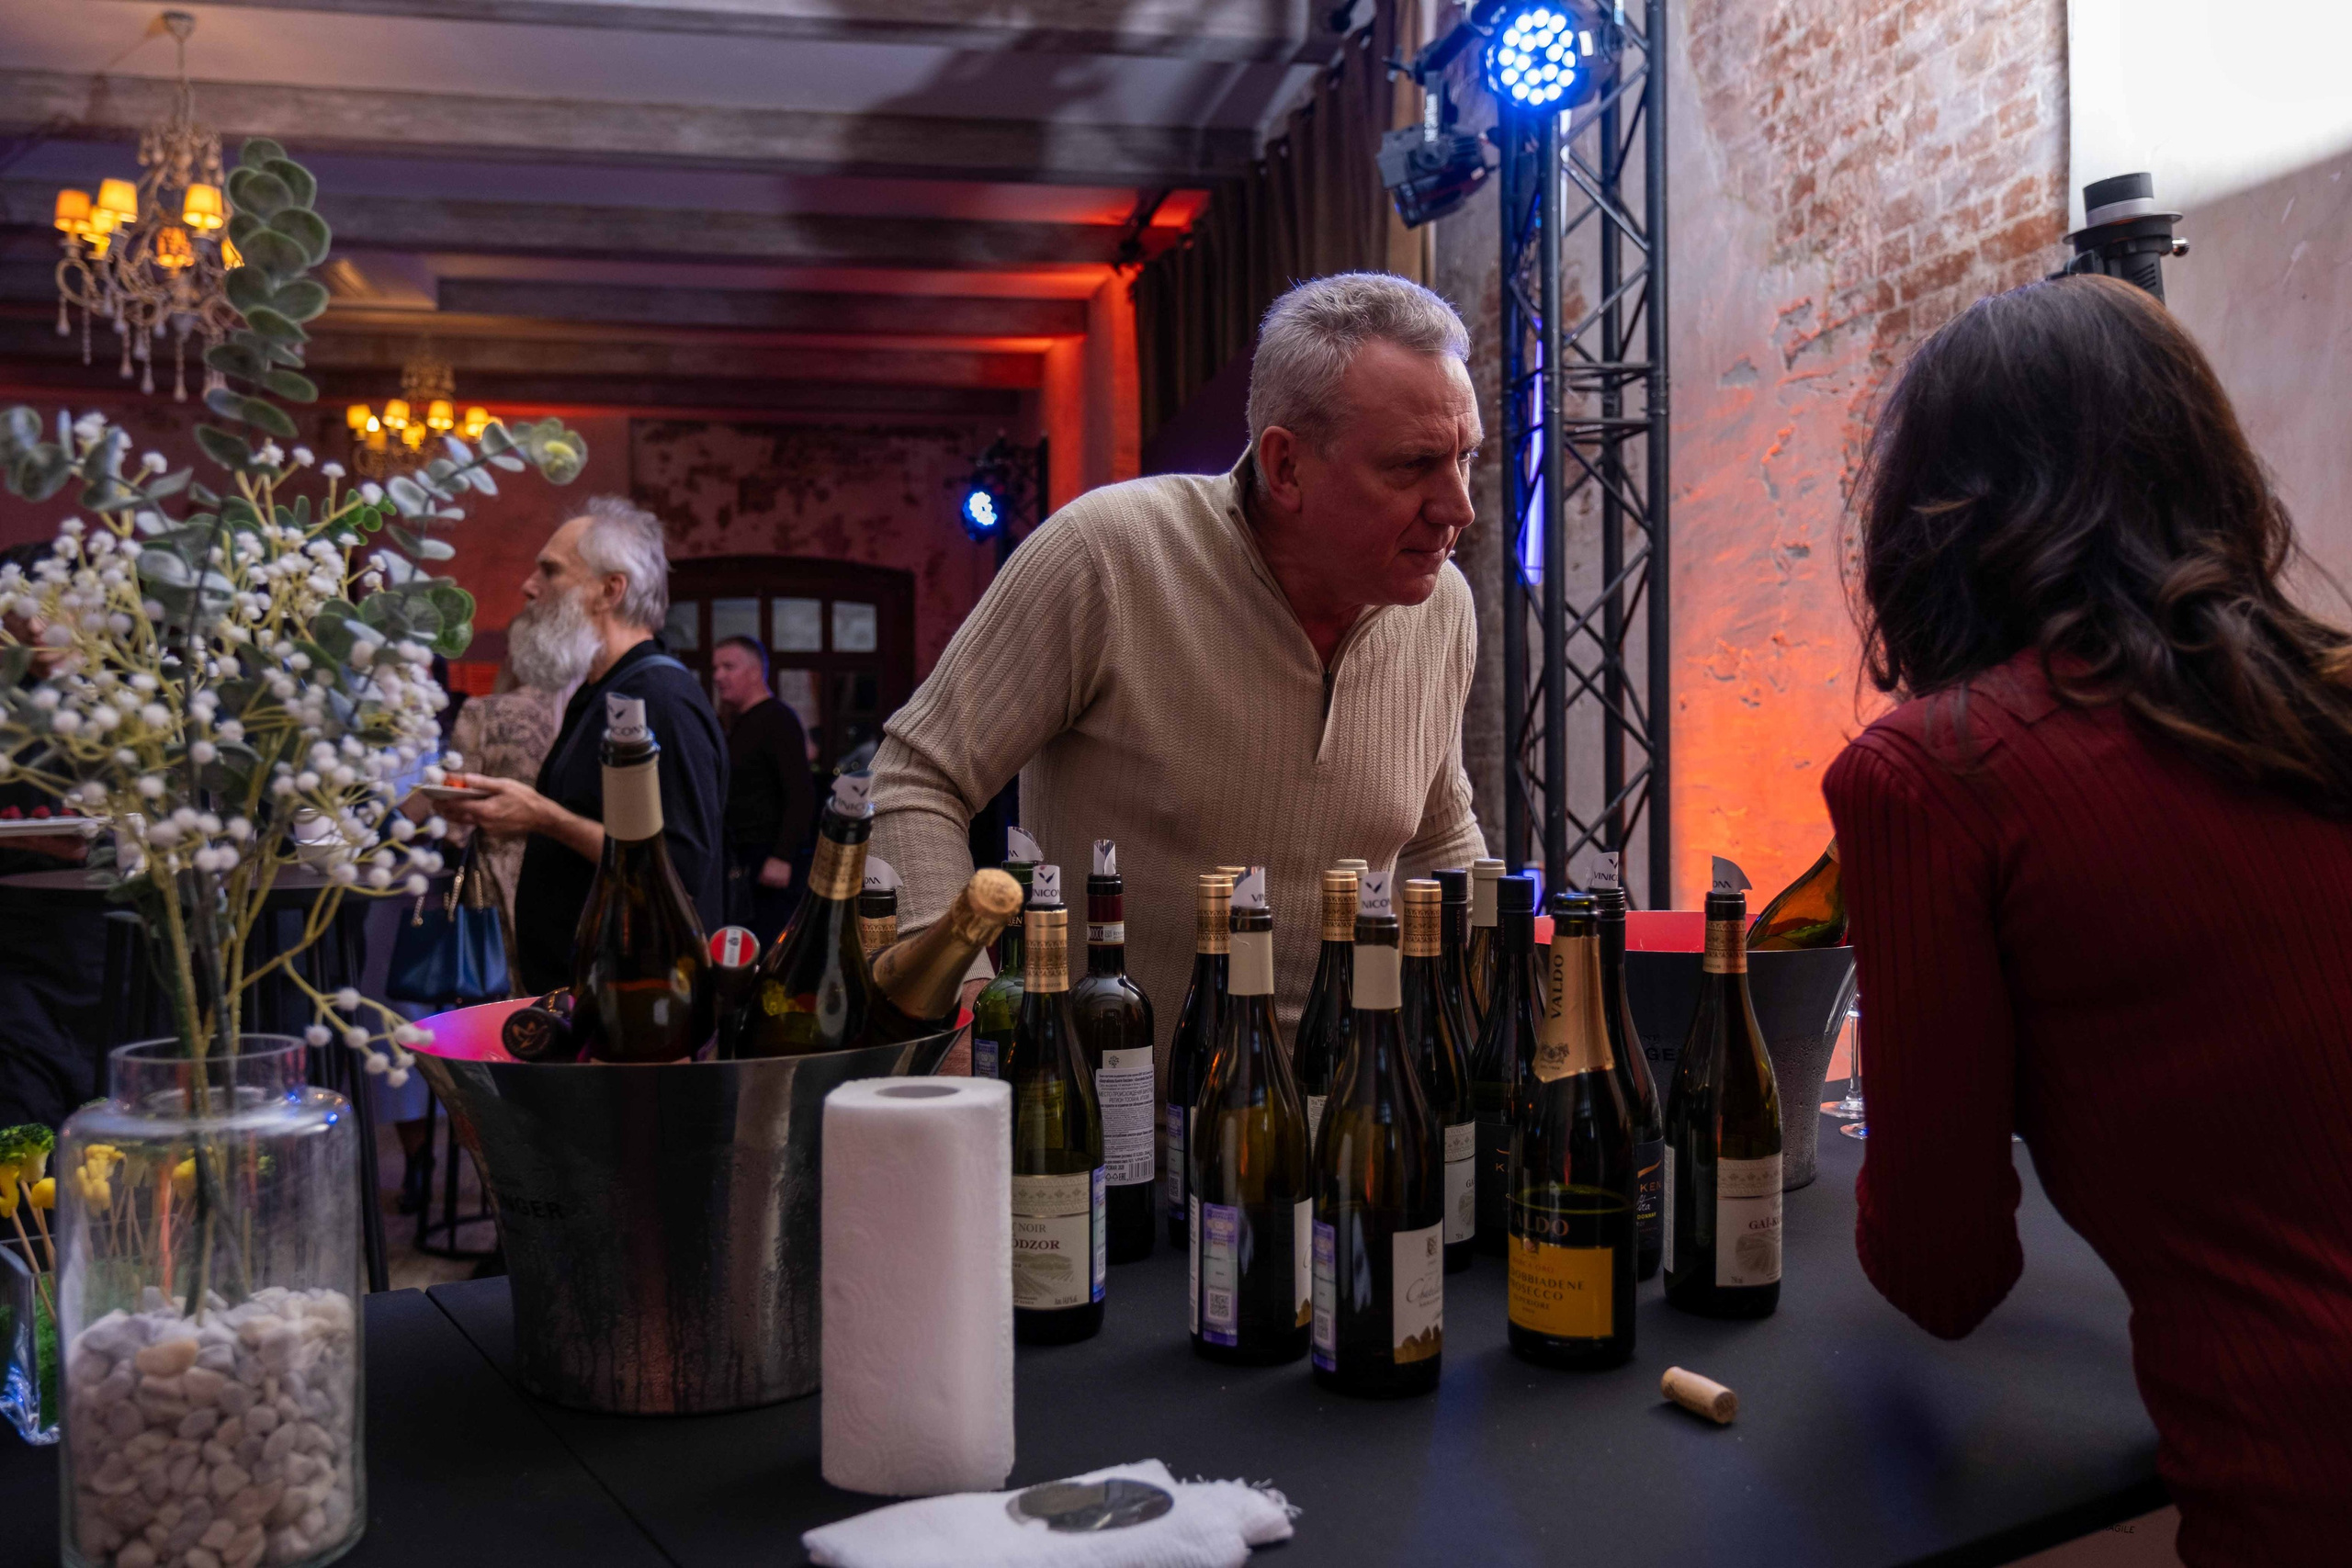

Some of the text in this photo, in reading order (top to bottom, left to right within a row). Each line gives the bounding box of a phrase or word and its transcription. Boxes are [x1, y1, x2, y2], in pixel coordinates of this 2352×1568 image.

[1594, 871, 1619, 882] VINIC
[1033, 888, 1060, 897] NICO
[1362, 898, 1390, 909] NICO
[1550, 954, 1564, 1019] VALDO
[1640, 1180, 1661, 1192] KEN
[1019, 1223, 1046, 1233] NOIR
[1514, 1210, 1569, 1236] ALDO
[1012, 1239, 1061, 1250] ODZOR
[1510, 1266, 1585, 1291] DOBBIADENE
[1510, 1278, 1564, 1302] ROSECCO
